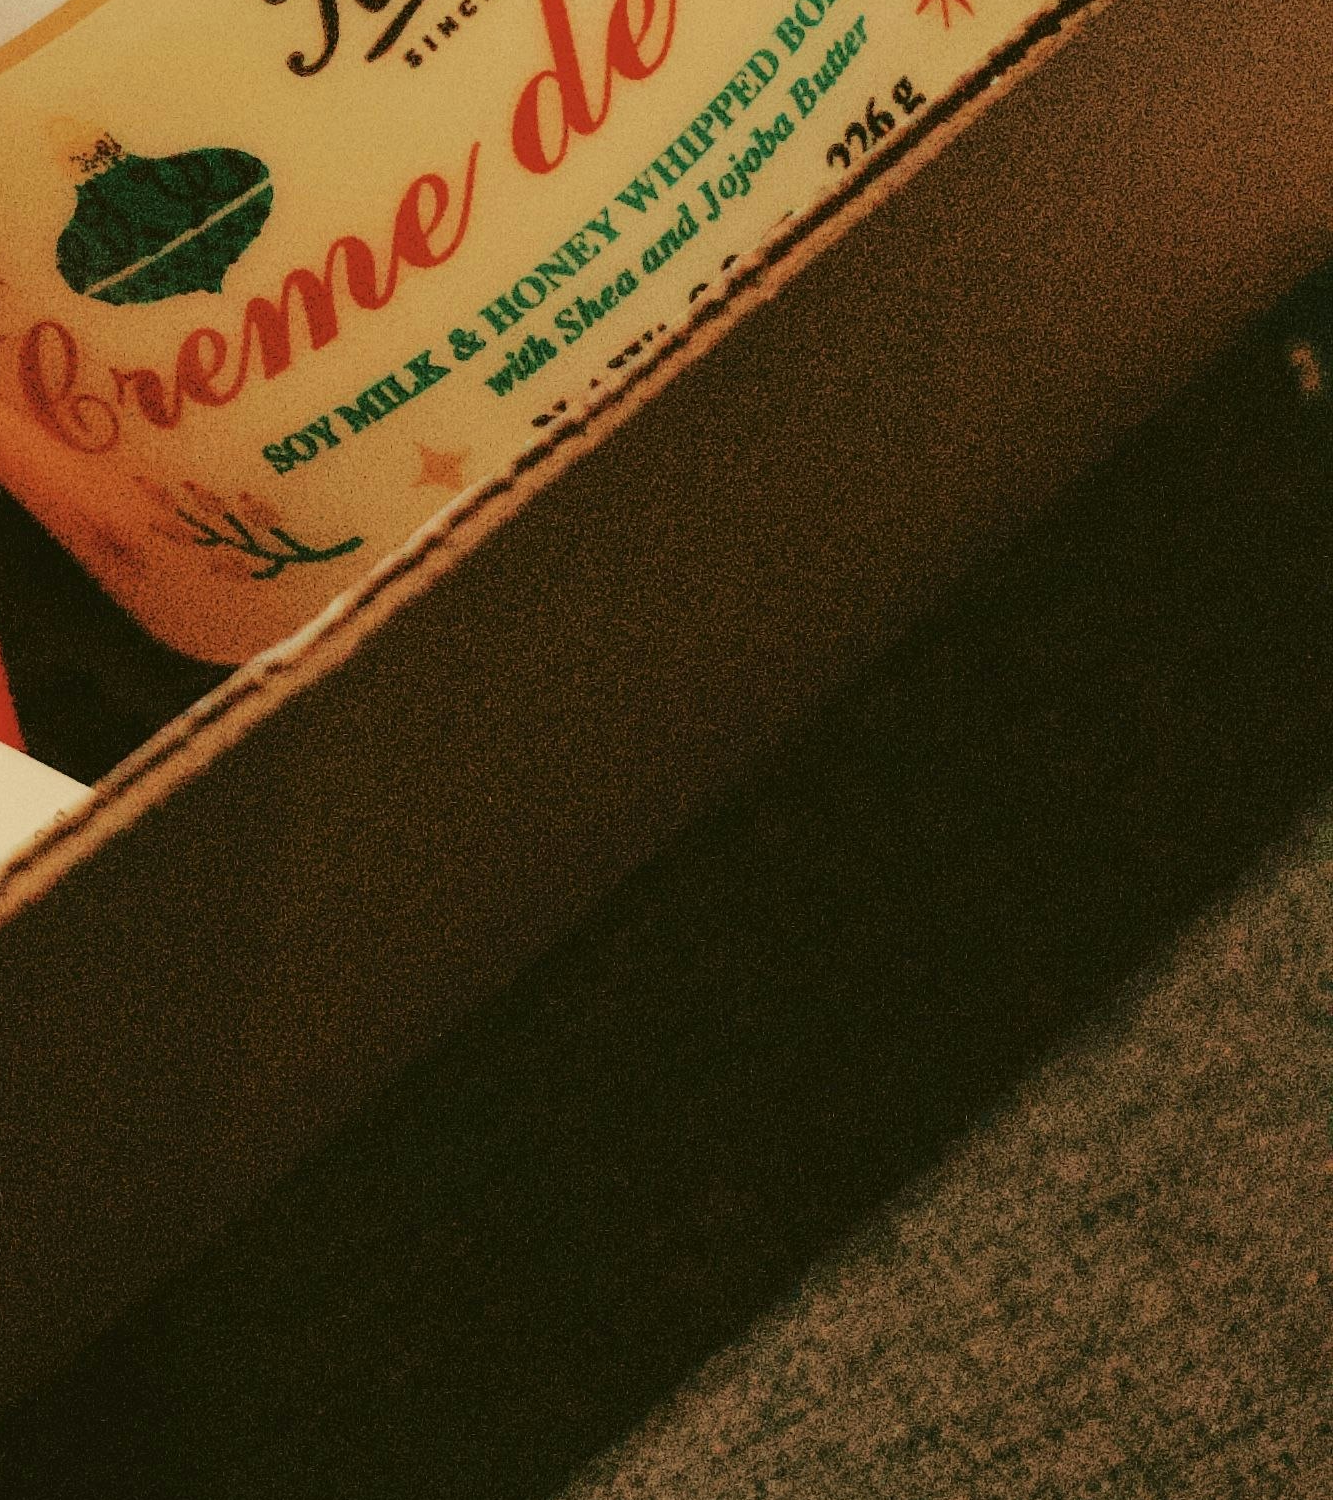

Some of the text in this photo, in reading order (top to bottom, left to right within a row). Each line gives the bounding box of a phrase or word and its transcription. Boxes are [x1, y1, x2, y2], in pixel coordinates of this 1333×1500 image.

[261, 415, 342, 475] SOY
[333, 349, 452, 435] MILK
[447, 327, 487, 361] &
[478, 206, 623, 336] HONEY
[614, 46, 781, 215] WHIPPED
[484, 334, 558, 397] with
[553, 268, 640, 346] Shea
[640, 202, 701, 275] and
[697, 111, 796, 223] Jojoba
[787, 13, 869, 120] Butter
